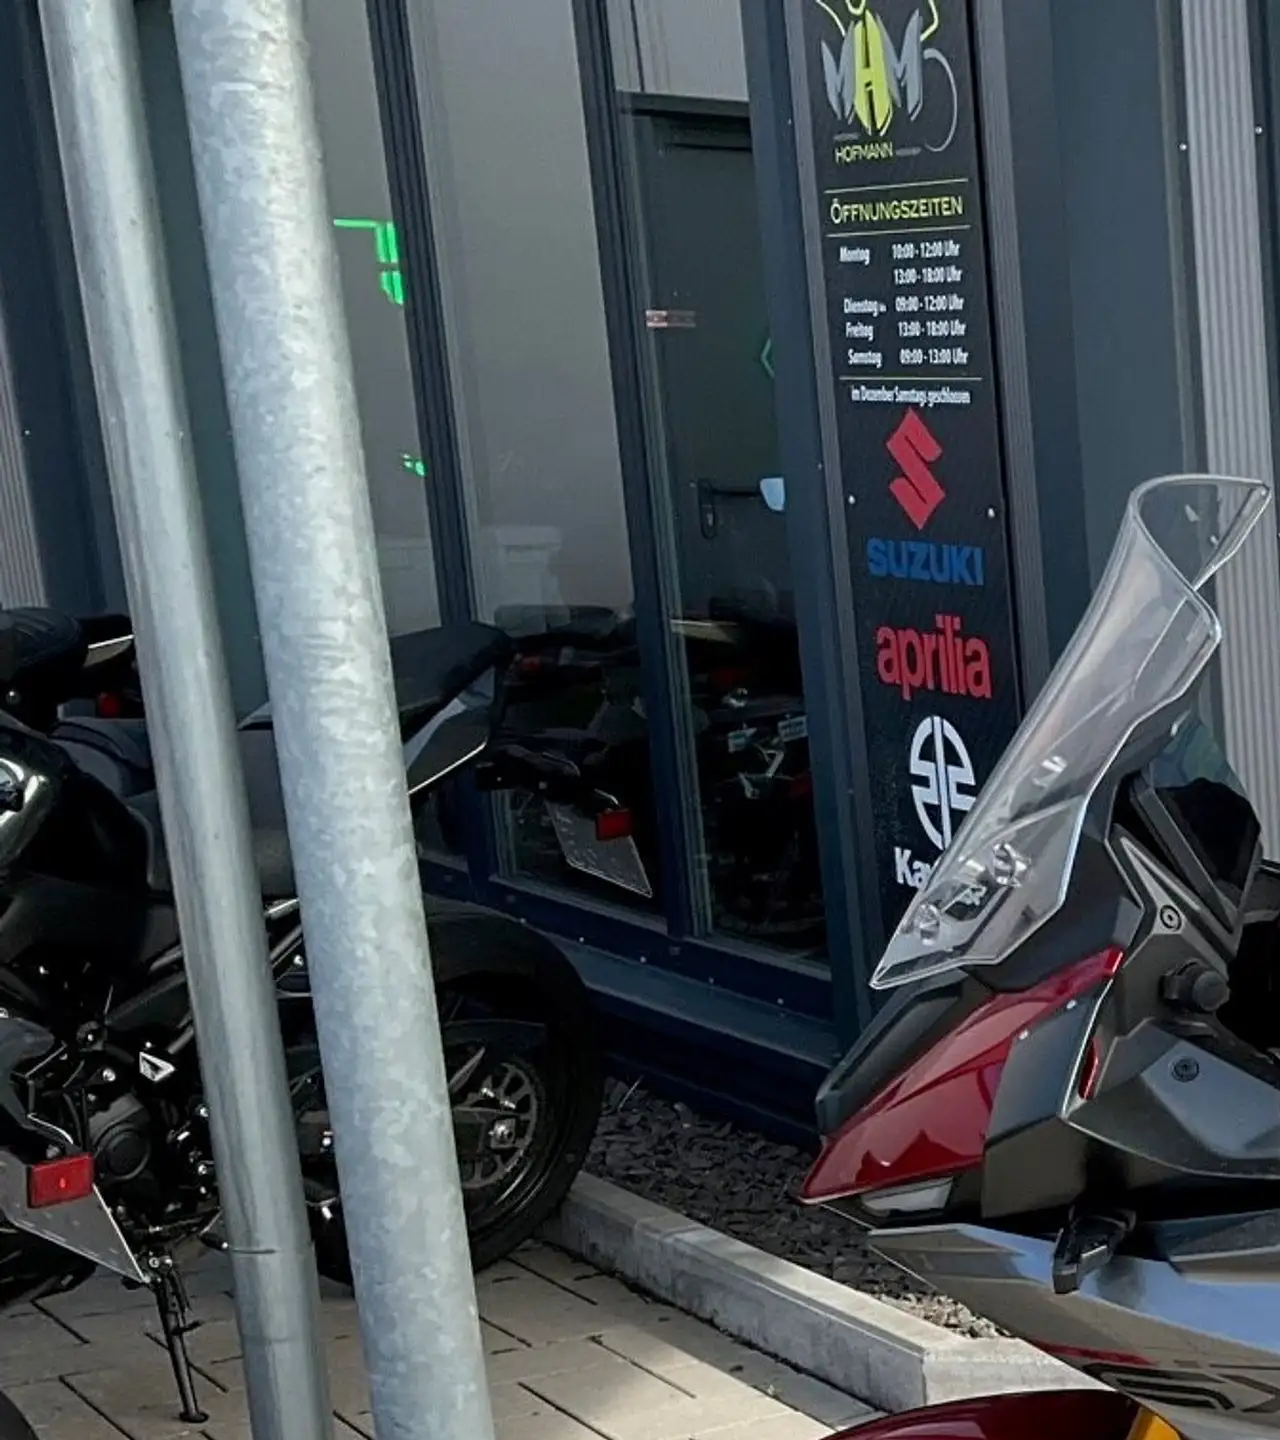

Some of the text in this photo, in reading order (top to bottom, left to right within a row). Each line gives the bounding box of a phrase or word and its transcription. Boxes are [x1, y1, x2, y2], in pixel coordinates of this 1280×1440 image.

[835, 141, 893, 164] HOFMANN
[830, 196, 964, 224] ÖFFNUNGSZEITEN
[866, 537, 984, 586] SUZUKI
[875, 613, 992, 701] aprilia
